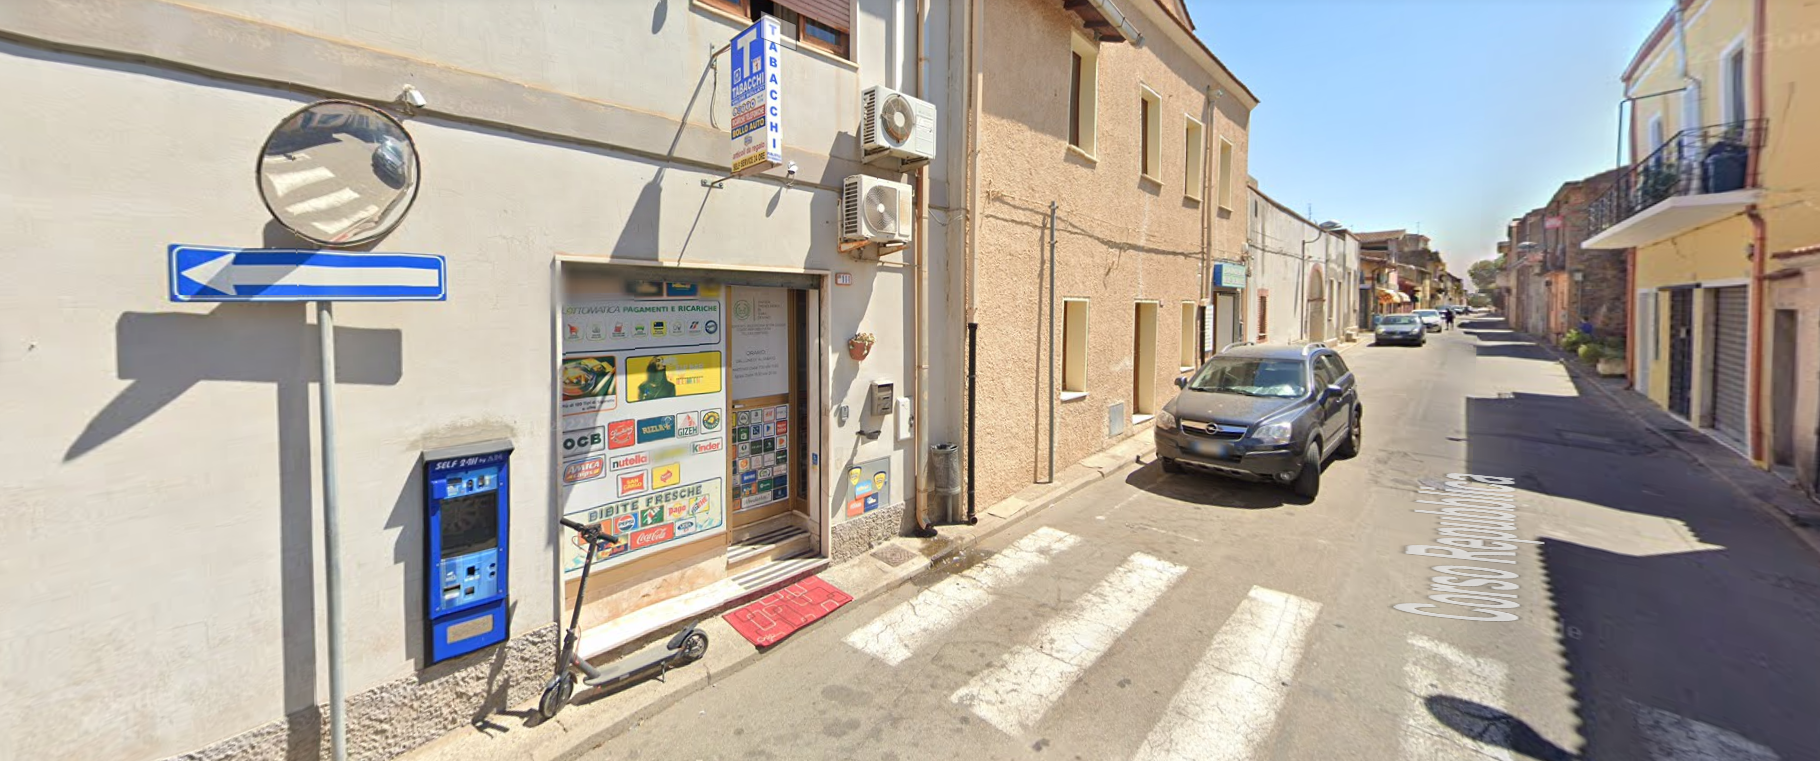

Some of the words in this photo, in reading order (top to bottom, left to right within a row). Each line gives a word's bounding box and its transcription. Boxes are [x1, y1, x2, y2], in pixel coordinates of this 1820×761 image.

[732, 72, 765, 98] TABACCHI
[768, 24, 778, 148] TABACCHI
[732, 126, 748, 138] BOLLO
[749, 118, 765, 132] AUTO
[677, 426, 698, 436] GIZEH
[563, 433, 602, 450] OCB
[435, 459, 457, 470] SELF
[613, 455, 647, 468] nutella
[623, 482, 642, 490] CARLO
[588, 501, 639, 522] BIBITE
[646, 485, 702, 507] FRESCHE
